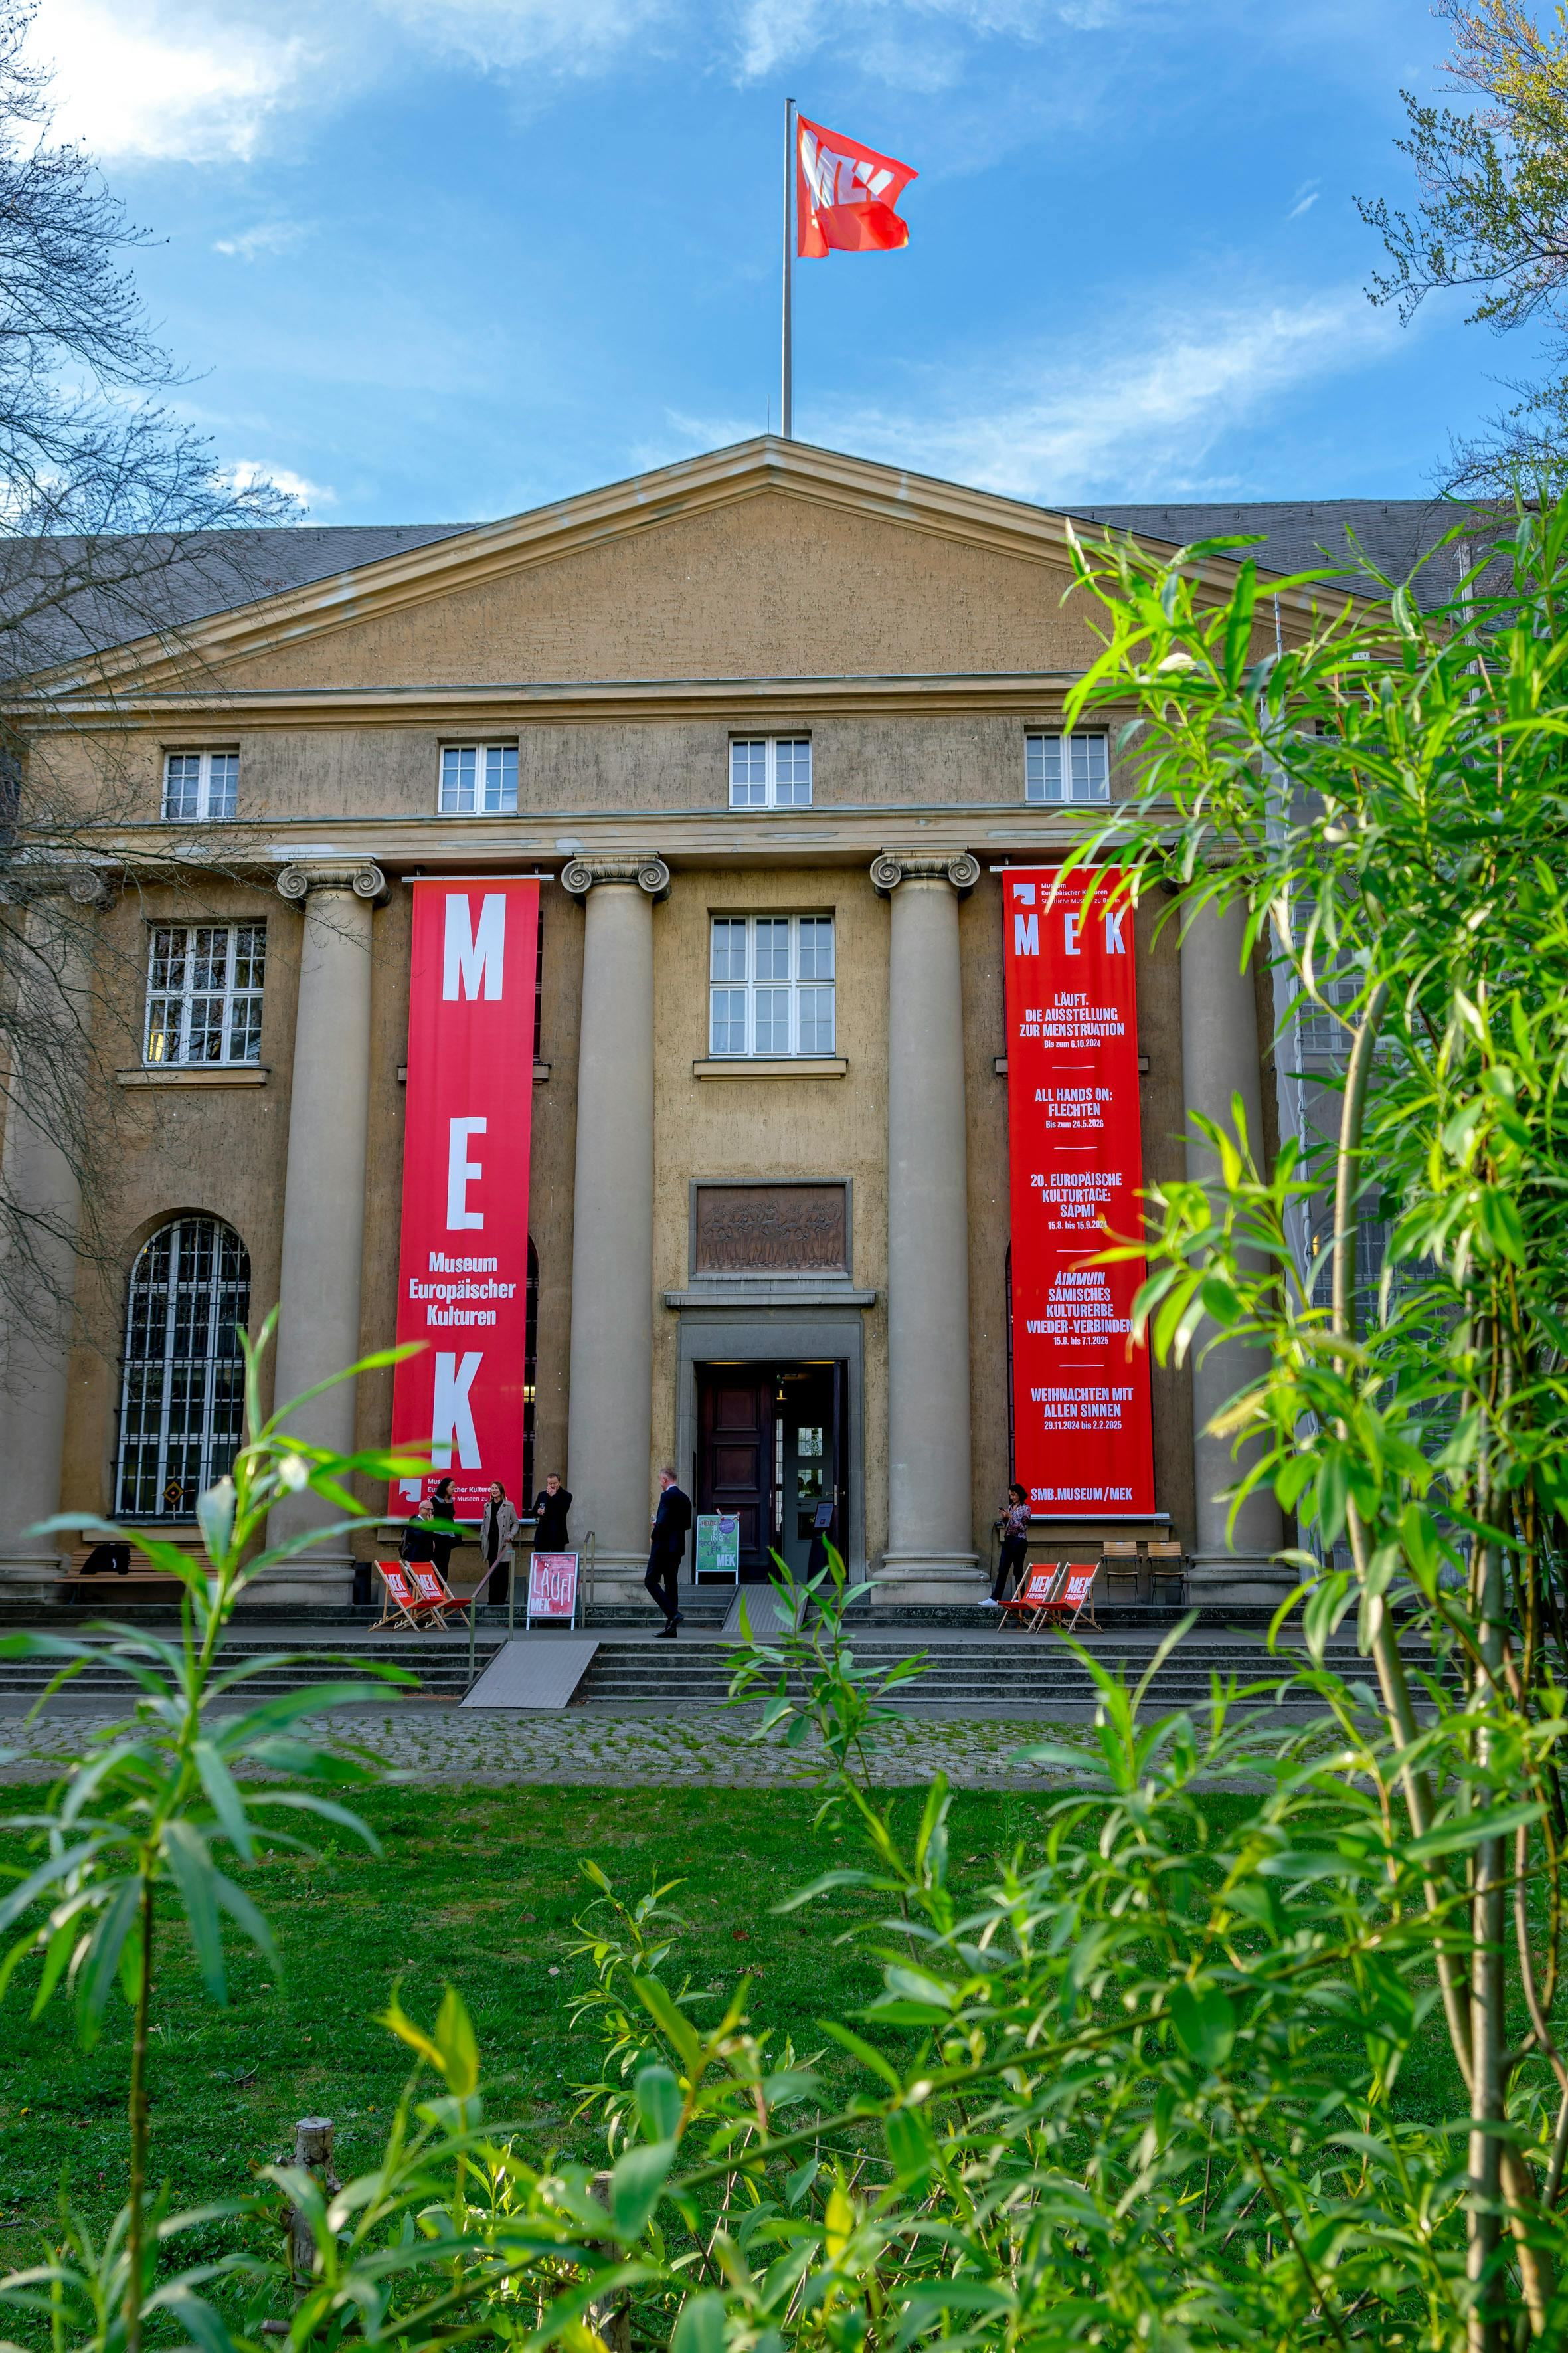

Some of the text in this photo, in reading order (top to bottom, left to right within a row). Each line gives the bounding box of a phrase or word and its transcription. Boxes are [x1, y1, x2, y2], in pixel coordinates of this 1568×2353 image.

[1054, 992, 1089, 1006] LÄUFT.
[1025, 1008, 1118, 1022] DIE AUSSTELLUNG
[1020, 1023, 1124, 1036] ZUR MENSTRUATION
[1071, 1039, 1100, 1048] 6.10.2024
[1035, 1088, 1112, 1101] ALL HANDS ON:
[1049, 1103, 1100, 1116] FLECHTEN
[1073, 1119, 1104, 1128] 24.5.2026
[1031, 1171, 1122, 1186] 20. EUROPÄISCHE
[1043, 1188, 1111, 1202] KULTURTAGE:
[1061, 1203, 1094, 1217] SÁPMI
[1048, 1221, 1063, 1230] 15.8.
[1076, 1220, 1108, 1229] 15.9.2024
[429, 1252, 497, 1273] Museum
[1055, 1271, 1105, 1285] ÁIMMUIN
[410, 1278, 516, 1304] Europäischer
[1049, 1287, 1110, 1301] SÁMISCHES
[427, 1305, 496, 1325] Kulturen
[1047, 1303, 1114, 1317] KULTURERBE
[1027, 1319, 1134, 1333] WIEDER-VERBINDEN
[1082, 1336, 1108, 1345] 7.1.2025
[1031, 1388, 1133, 1401] WEIHNACHTEN MIT
[1044, 1404, 1121, 1417] ALLEN SINNEN
[717, 1554, 735, 1566] MEK
[533, 1559, 574, 1606] LÄUFT
[531, 1598, 551, 1612] MEK
